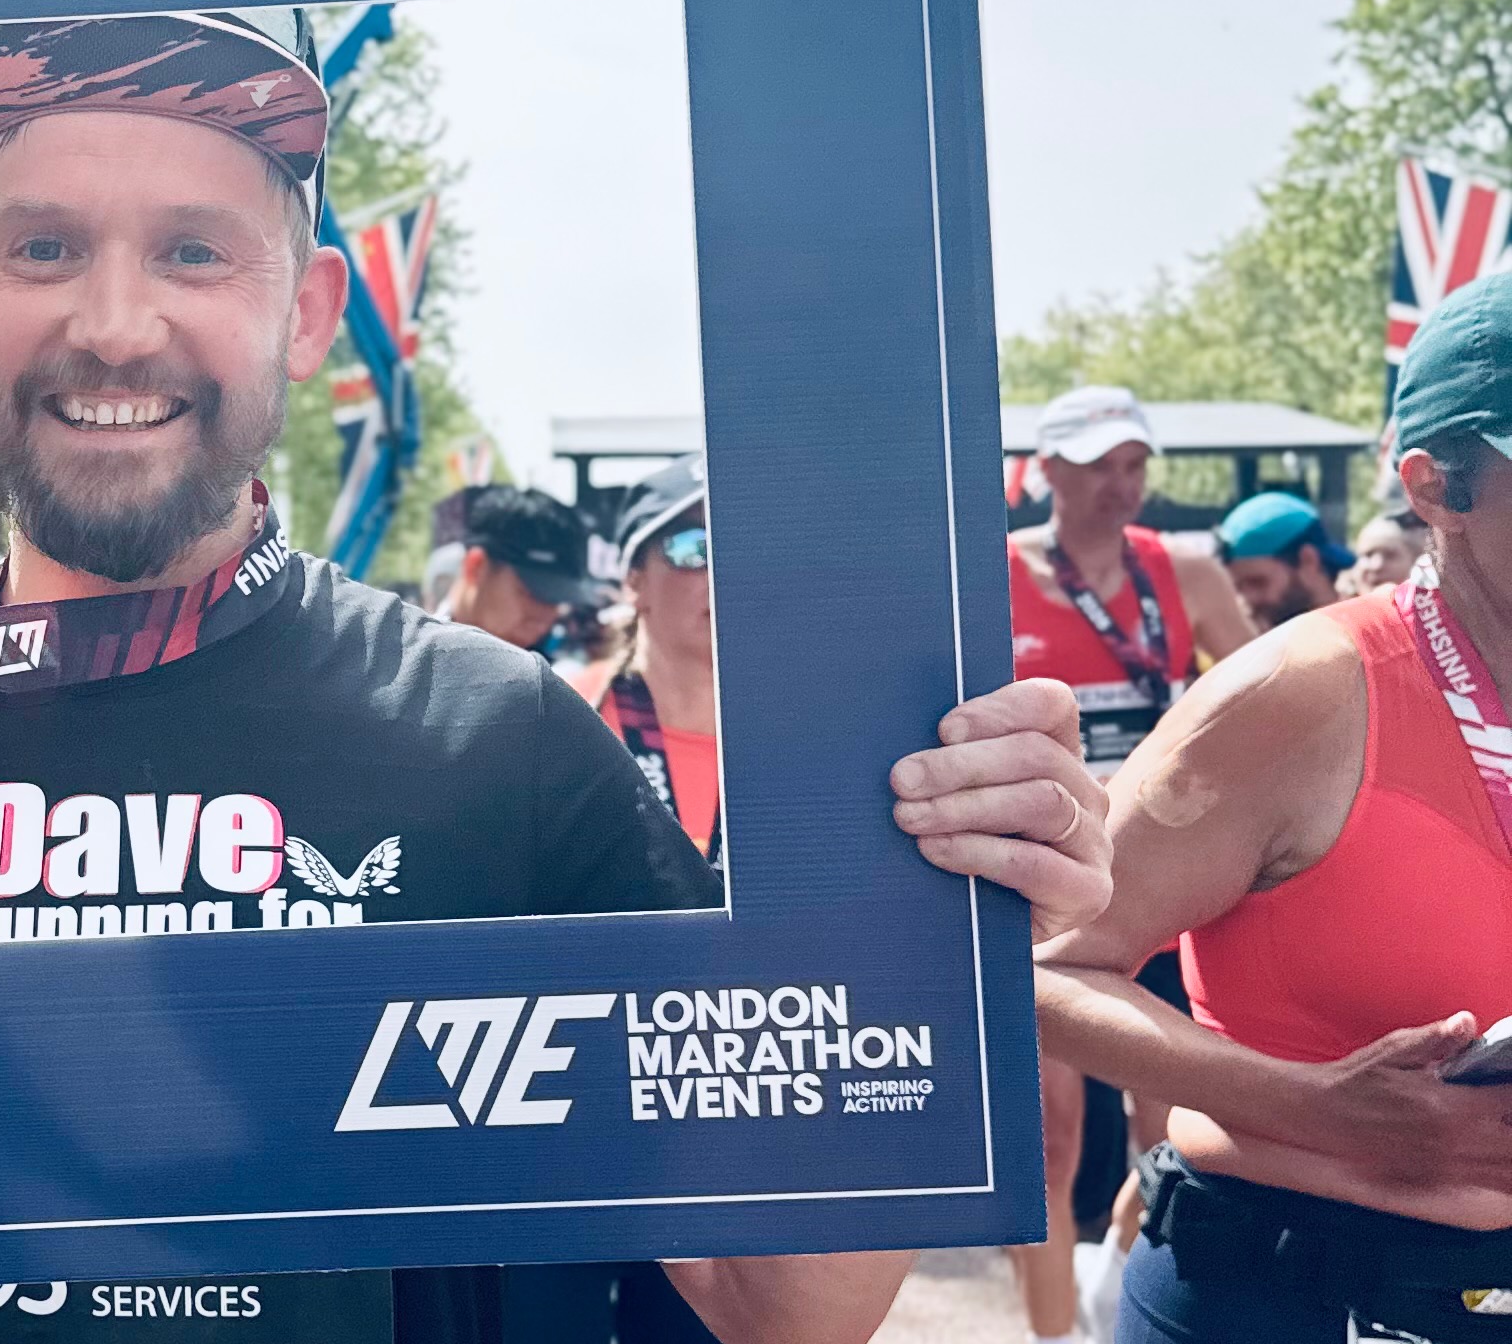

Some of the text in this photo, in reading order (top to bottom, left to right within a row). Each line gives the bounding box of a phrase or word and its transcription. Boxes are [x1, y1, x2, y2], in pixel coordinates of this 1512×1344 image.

[259, 888, 364, 930] for
[625, 984, 848, 1034] LONDON
[628, 1025, 933, 1078] MARATHON
[631, 1072, 823, 1121] EVENTS
[841, 1078, 934, 1098] INSPIRING
[842, 1094, 928, 1114] ACTIVITY
[91, 1285, 261, 1318] SERVICES
